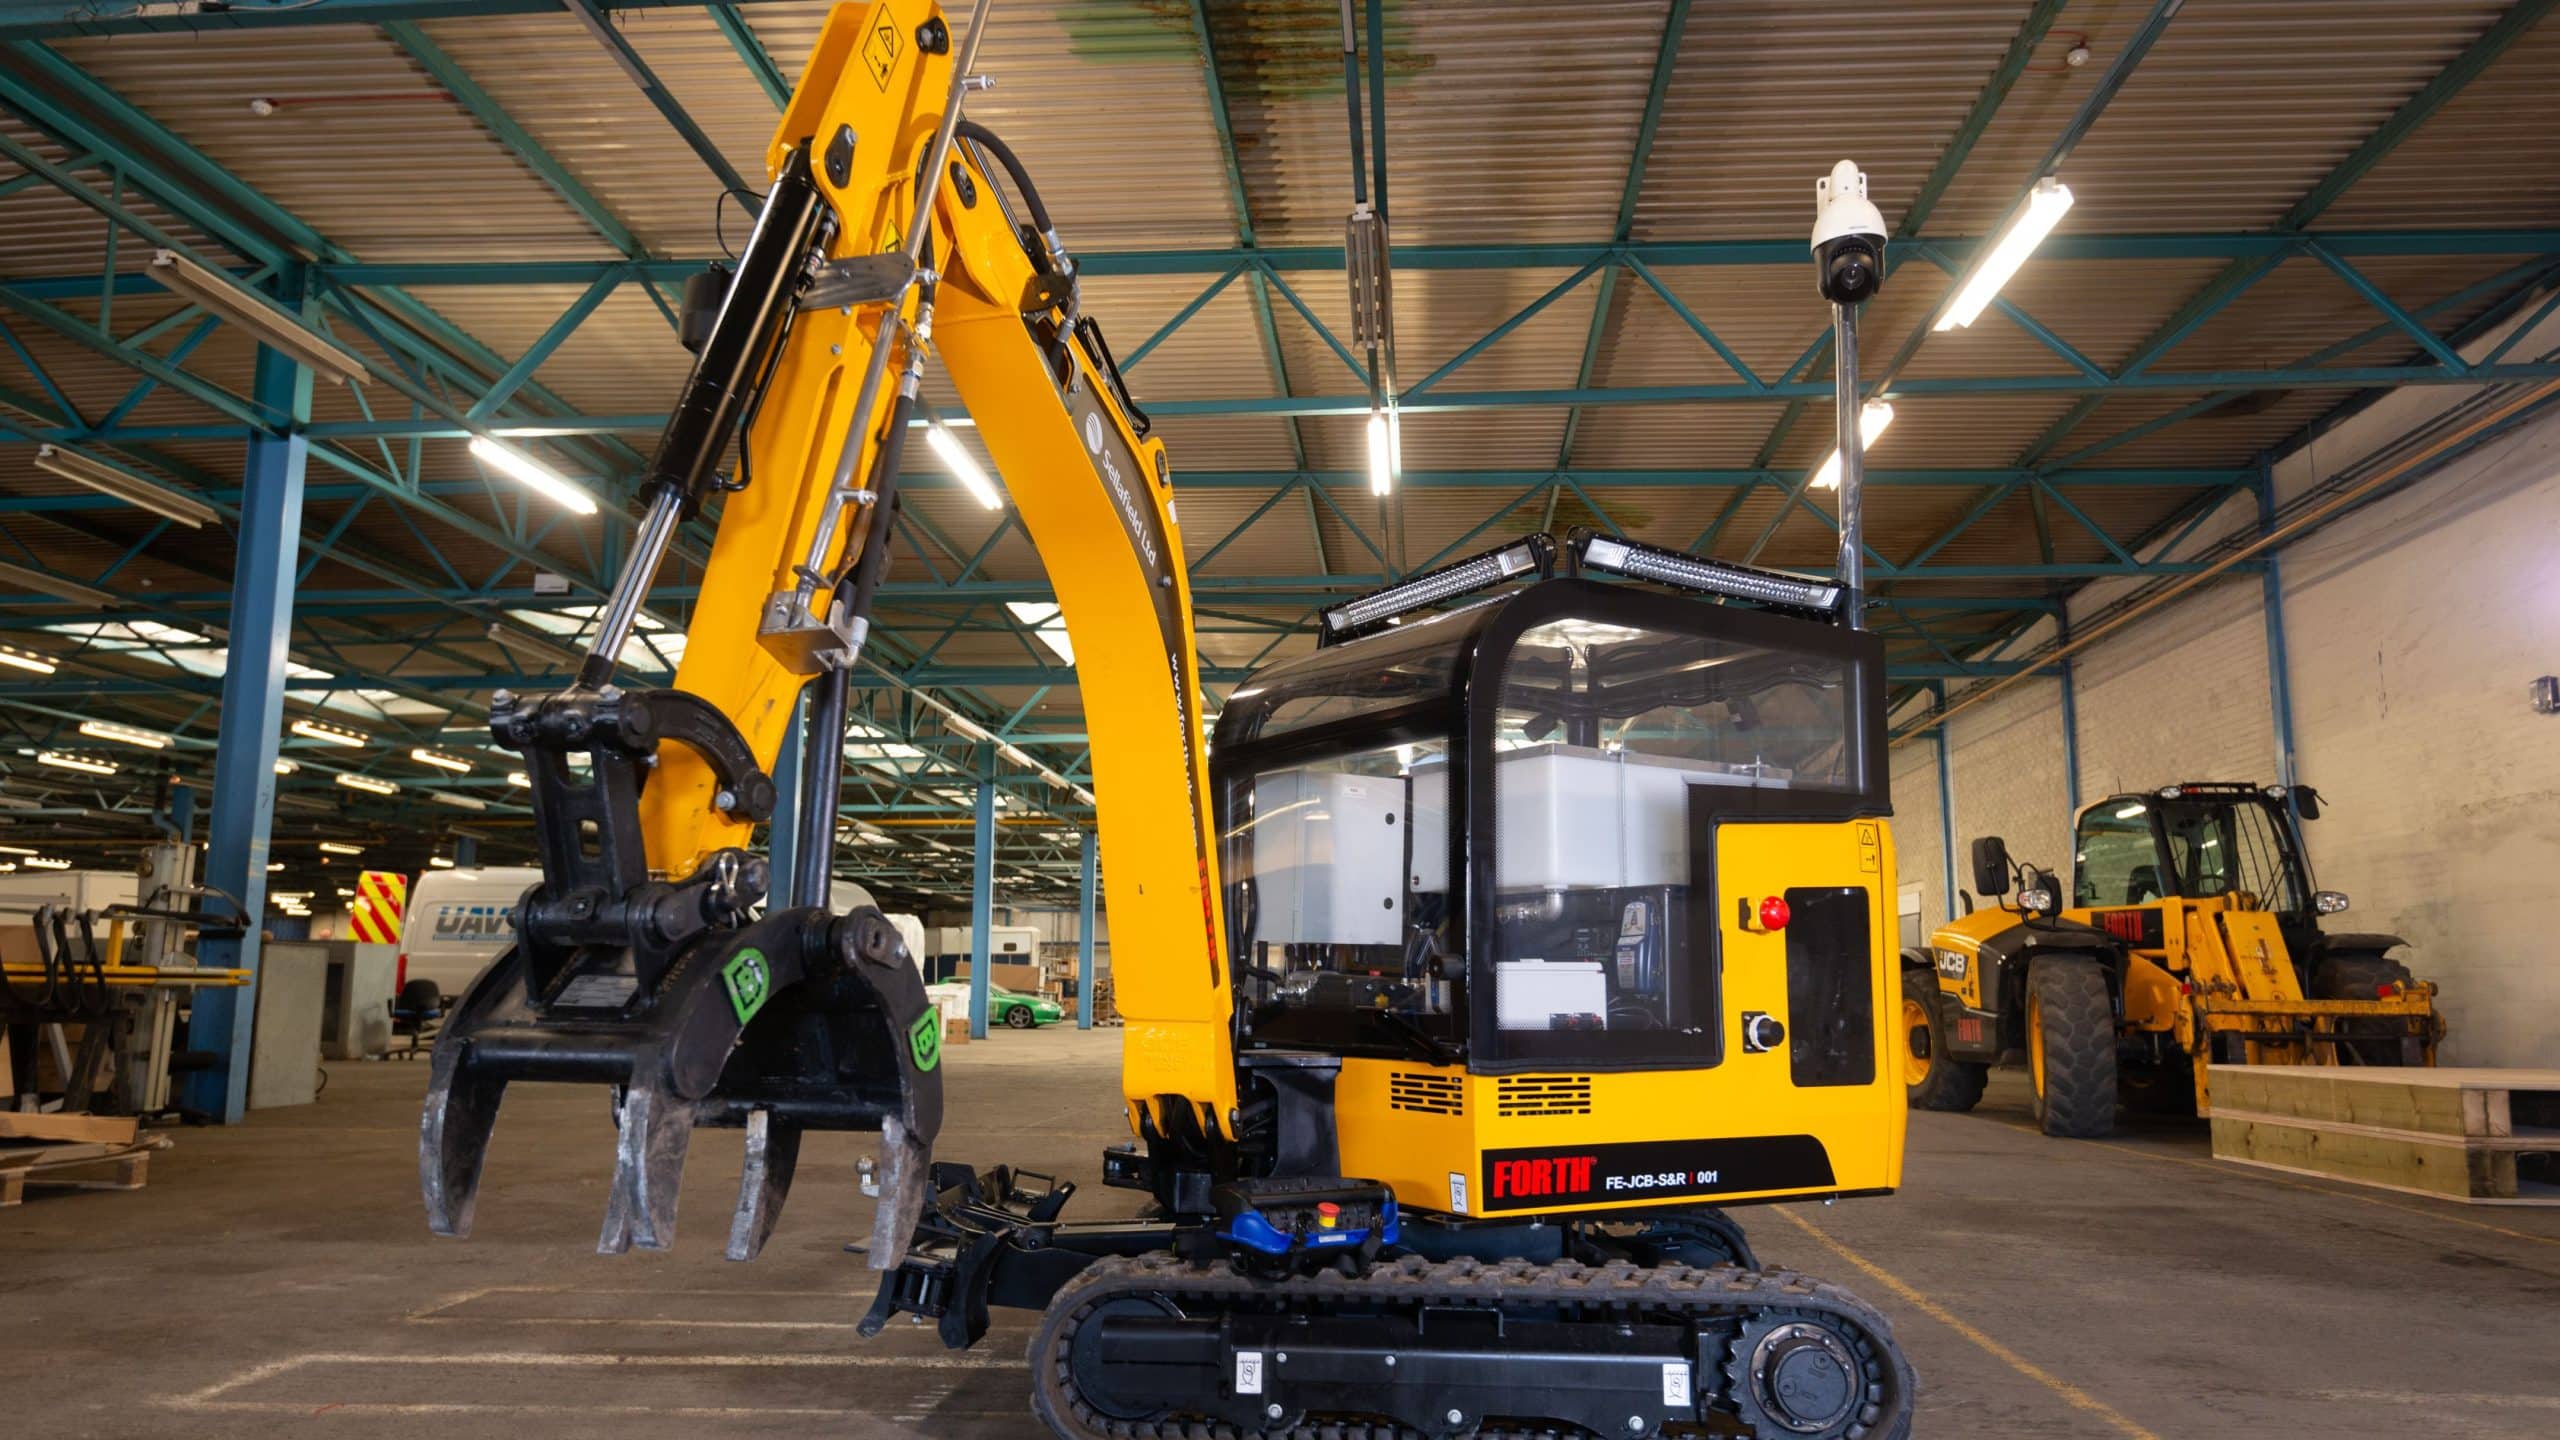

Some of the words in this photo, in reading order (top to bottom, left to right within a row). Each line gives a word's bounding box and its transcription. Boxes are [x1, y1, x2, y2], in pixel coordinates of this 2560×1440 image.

[1102, 448, 1142, 538] Sellafield
[1141, 530, 1156, 568] Ltd
[1939, 950, 1966, 973] JCB
[1605, 1172, 1686, 1190] FE-JCB-S&R
[1697, 1170, 1718, 1184] 001
